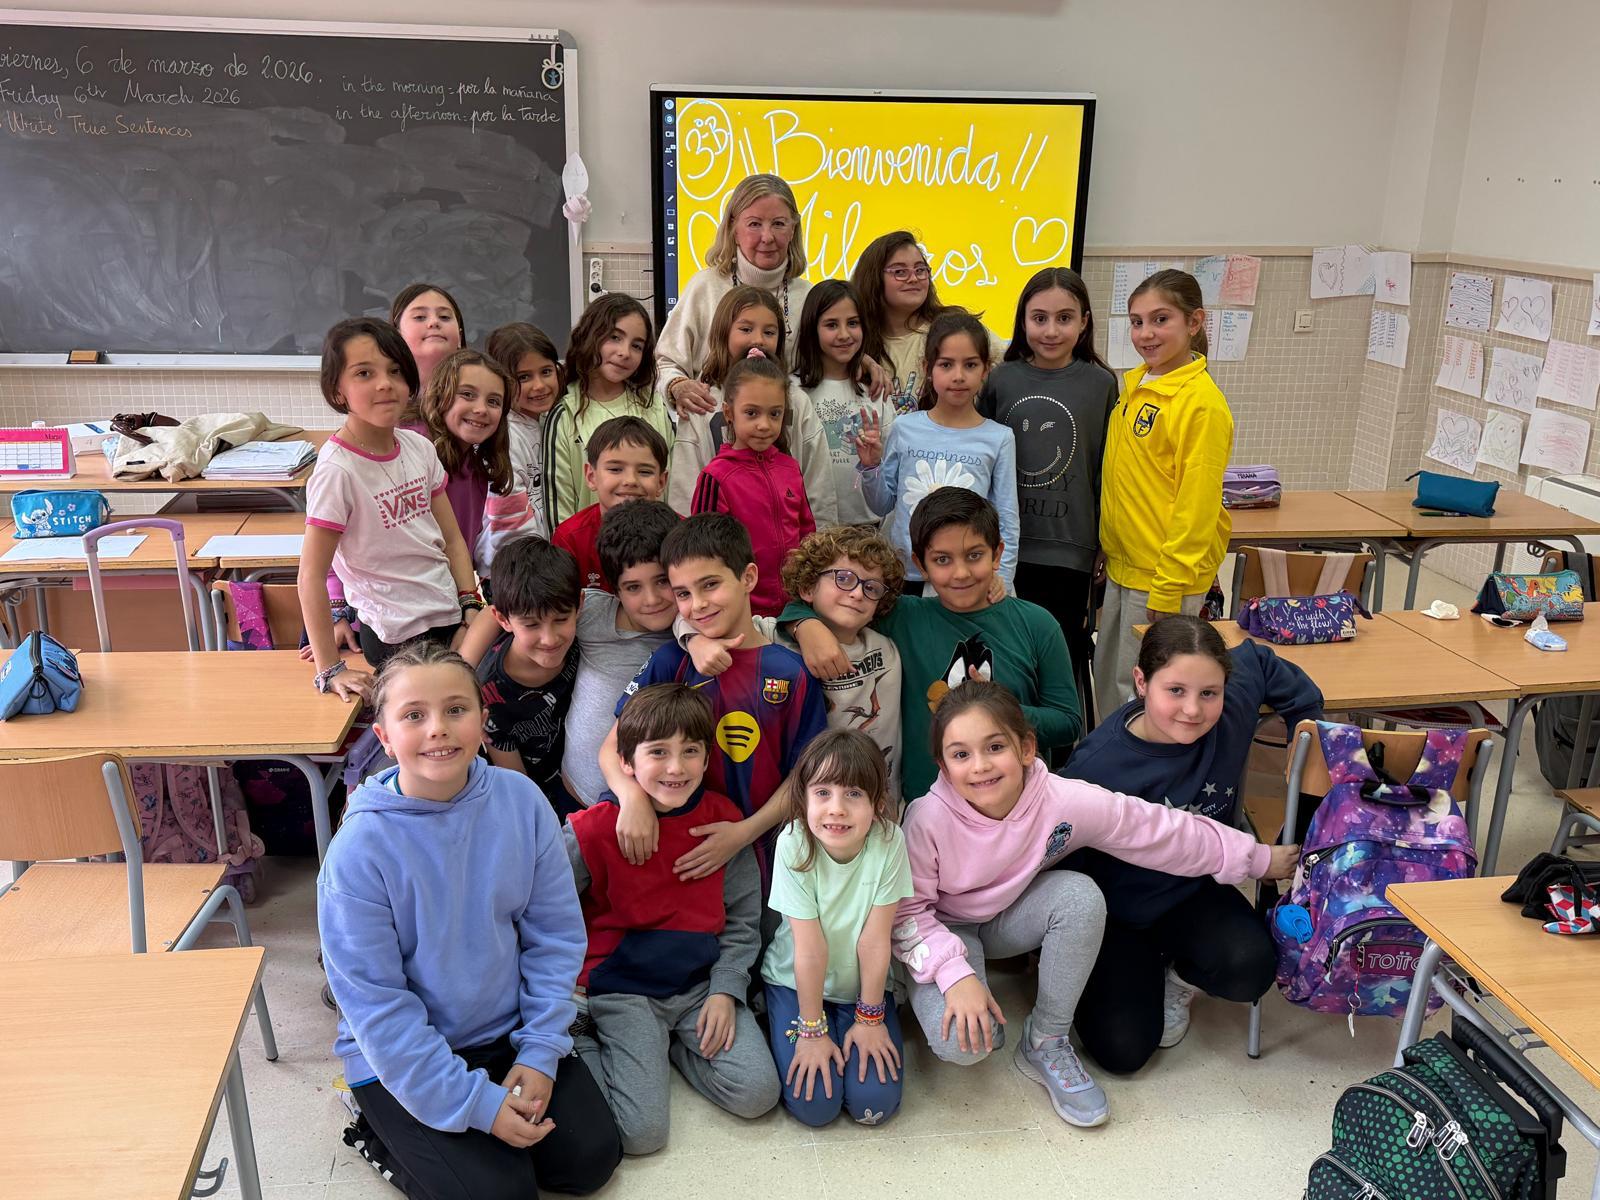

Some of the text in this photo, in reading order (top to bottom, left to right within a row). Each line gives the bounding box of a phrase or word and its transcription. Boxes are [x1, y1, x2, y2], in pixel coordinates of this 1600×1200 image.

[75, 46, 94, 74] 6
[107, 48, 137, 75] de
[148, 58, 214, 77] marzo
[224, 52, 249, 77] de
[0, 78, 240, 119] Friday 6th March 2026
[342, 75, 356, 93] in
[360, 74, 386, 93] the
[483, 76, 497, 94] la
[503, 85, 559, 103] mañana
[335, 105, 353, 120] in
[360, 103, 384, 119] the
[502, 104, 516, 121] la
[6, 110, 192, 138] Write True Sentences
[907, 445, 982, 466] happiness
[1023, 497, 1069, 518] RLD
[52, 515, 92, 526] STITCH
[1294, 609, 1326, 621] Go with
[1296, 619, 1309, 630] the
